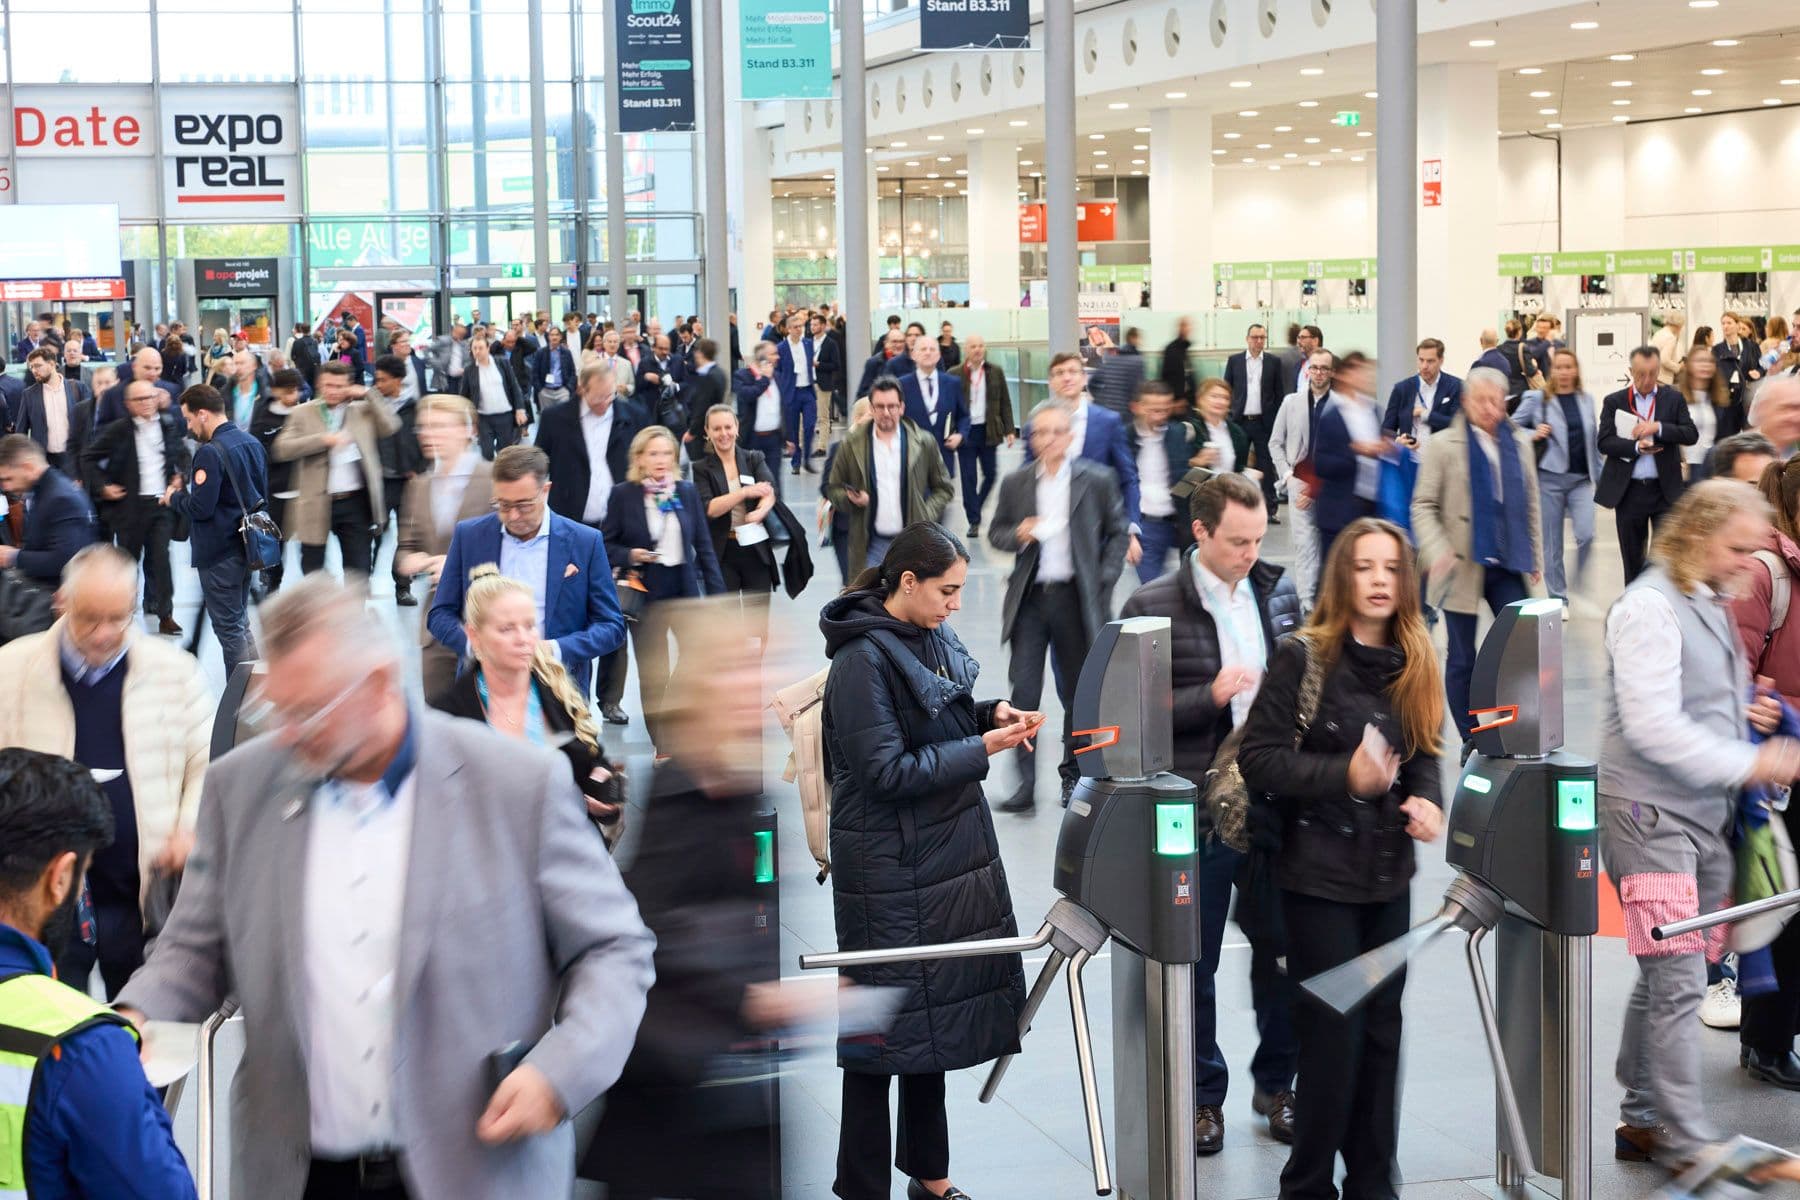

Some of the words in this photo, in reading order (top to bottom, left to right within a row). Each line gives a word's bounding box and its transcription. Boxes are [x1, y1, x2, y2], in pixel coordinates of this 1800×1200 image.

[927, 0, 967, 11] Stand
[969, 0, 1010, 11] B3.311
[627, 14, 681, 27] Scout24
[747, 59, 779, 69] Stand
[781, 58, 815, 68] B3.311
[623, 98, 651, 107] Stand
[652, 98, 681, 107] B3.311
[14, 106, 141, 147] Date
[174, 114, 283, 152] expo
[216, 268, 269, 280] apoprojekt
